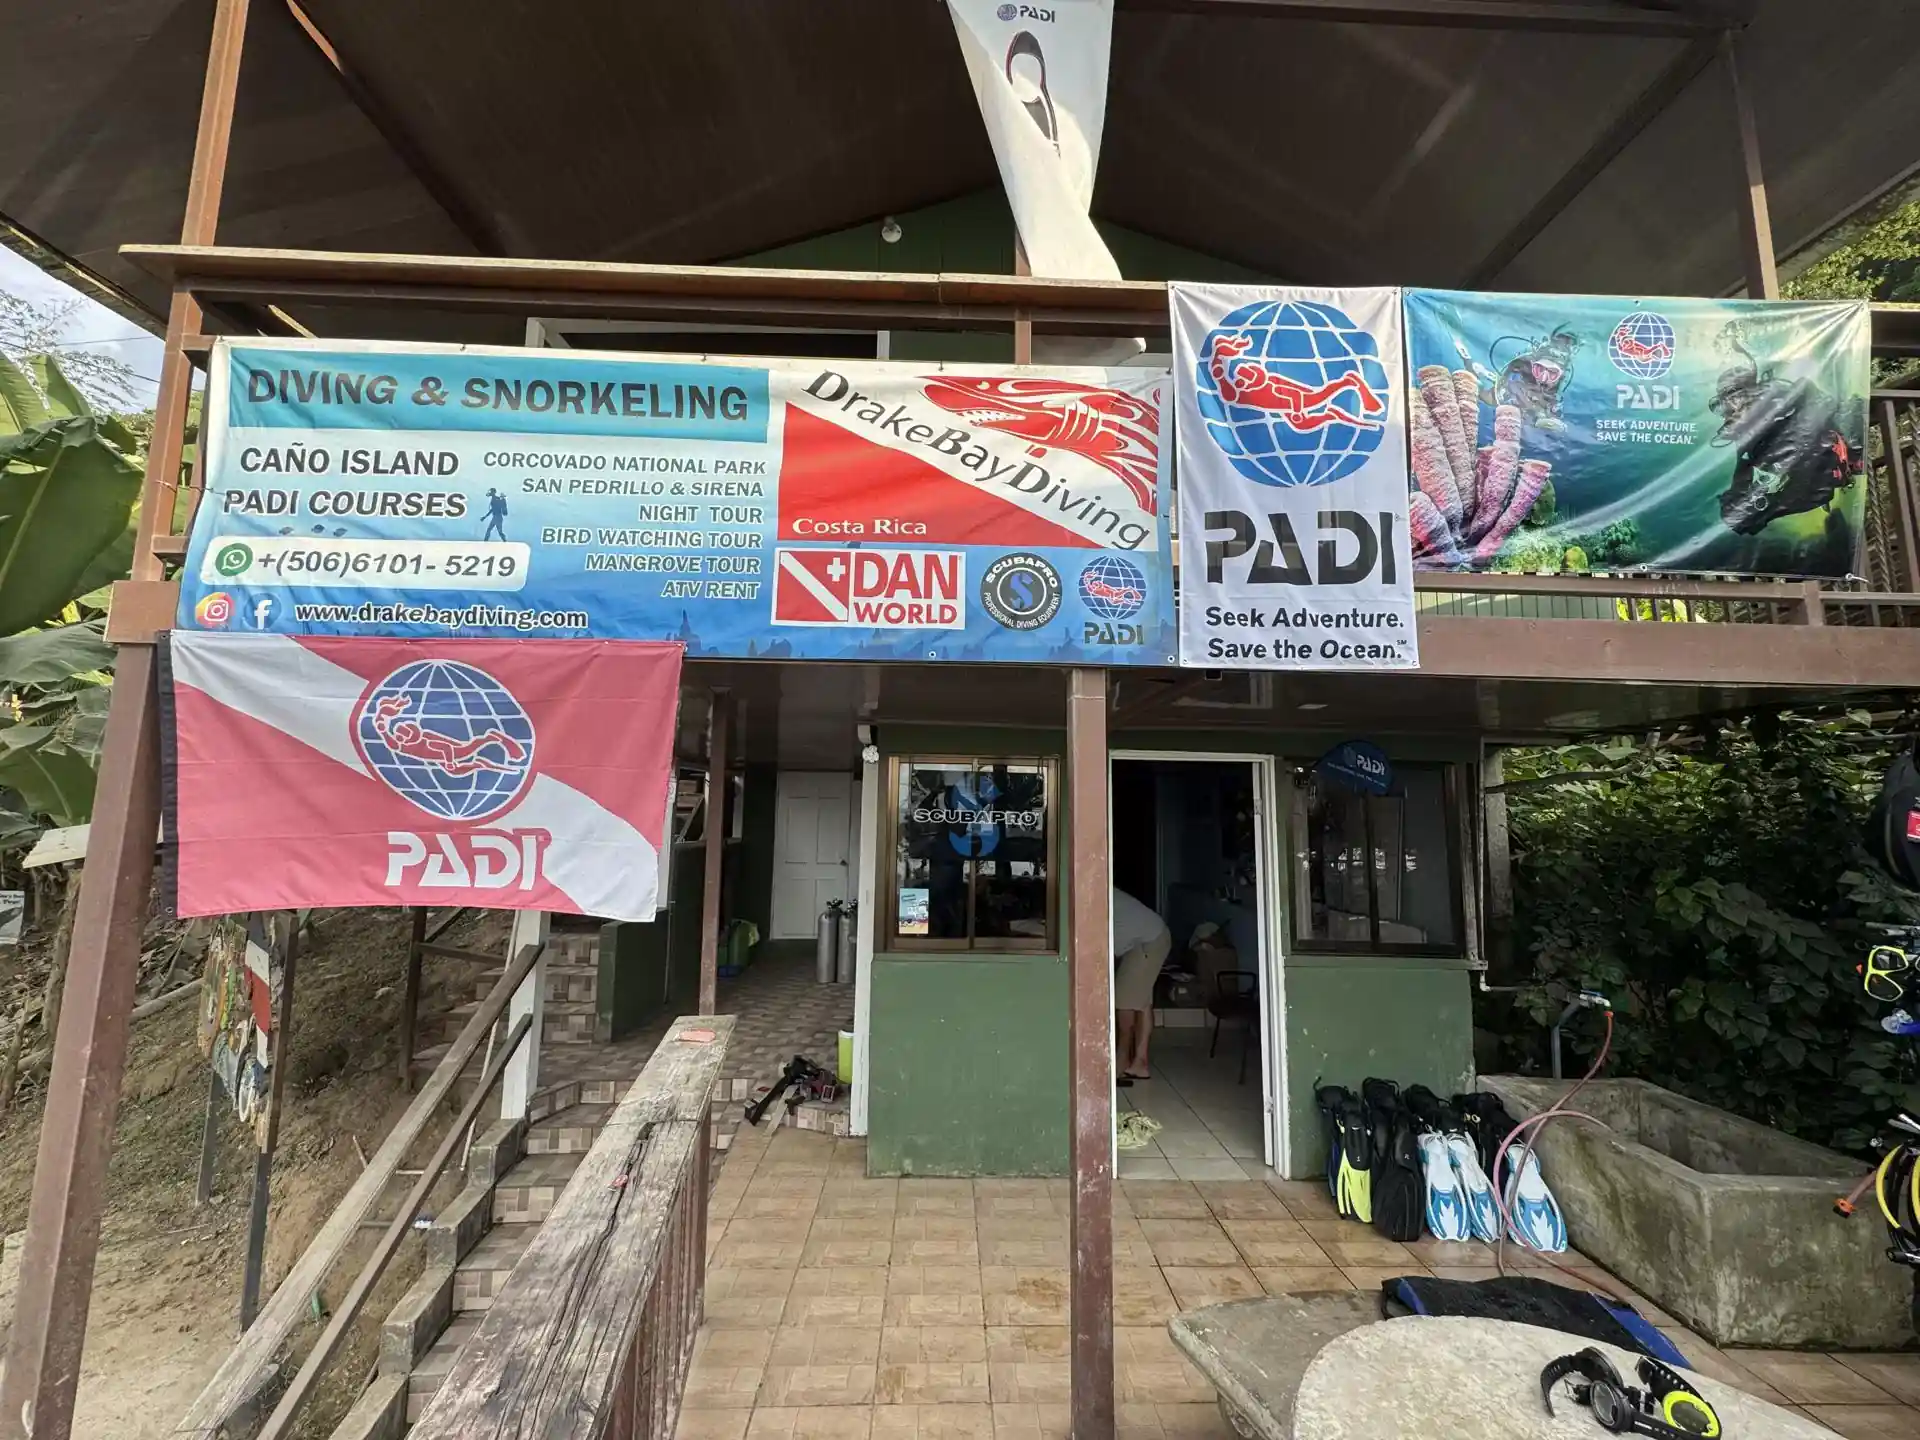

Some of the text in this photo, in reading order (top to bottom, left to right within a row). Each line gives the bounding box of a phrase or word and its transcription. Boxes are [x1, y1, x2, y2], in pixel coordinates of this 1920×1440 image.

[1020, 5, 1056, 23] PADI
[248, 369, 747, 421] DIVING & SNORKELING
[1616, 384, 1681, 410] PADI
[1596, 419, 1626, 430] SEEK
[1596, 431, 1626, 442] SAVE
[1630, 432, 1652, 443] THE
[240, 442, 460, 476] CAÑO ISLAND
[484, 451, 766, 475] CORCOVADO NATIONAL PARK
[801, 368, 1150, 550] DrakeBayDiving
[522, 478, 764, 497] SAN PEDRILLO & SIRENA
[223, 489, 467, 517] PADI COURSES
[639, 505, 764, 524] NIGHT TOUR
[792, 517, 927, 535] Costa Rica
[542, 528, 762, 548] BIRD WATCHING TOUR
[1204, 510, 1396, 585] PADI
[444, 555, 516, 577] 5219
[586, 554, 760, 574] MANGROVE TOUR
[986, 556, 1058, 588] SCUBAPRO
[854, 552, 958, 600] DAN
[662, 581, 760, 599] ATV RENT
[296, 603, 587, 630] www.drakebaydiving.com
[854, 602, 958, 625] WORLD
[984, 591, 1061, 629] PROFESSIONAL DIVING EQUIPMENT
[1206, 605, 1404, 629] Seek Adventure.
[1084, 621, 1144, 645] PADI
[1208, 637, 1266, 659] Save
[1273, 639, 1313, 659] the
[1356, 754, 1385, 776] PADI
[913, 808, 1038, 826] SCUBAPRO
[384, 831, 537, 891] PADI
